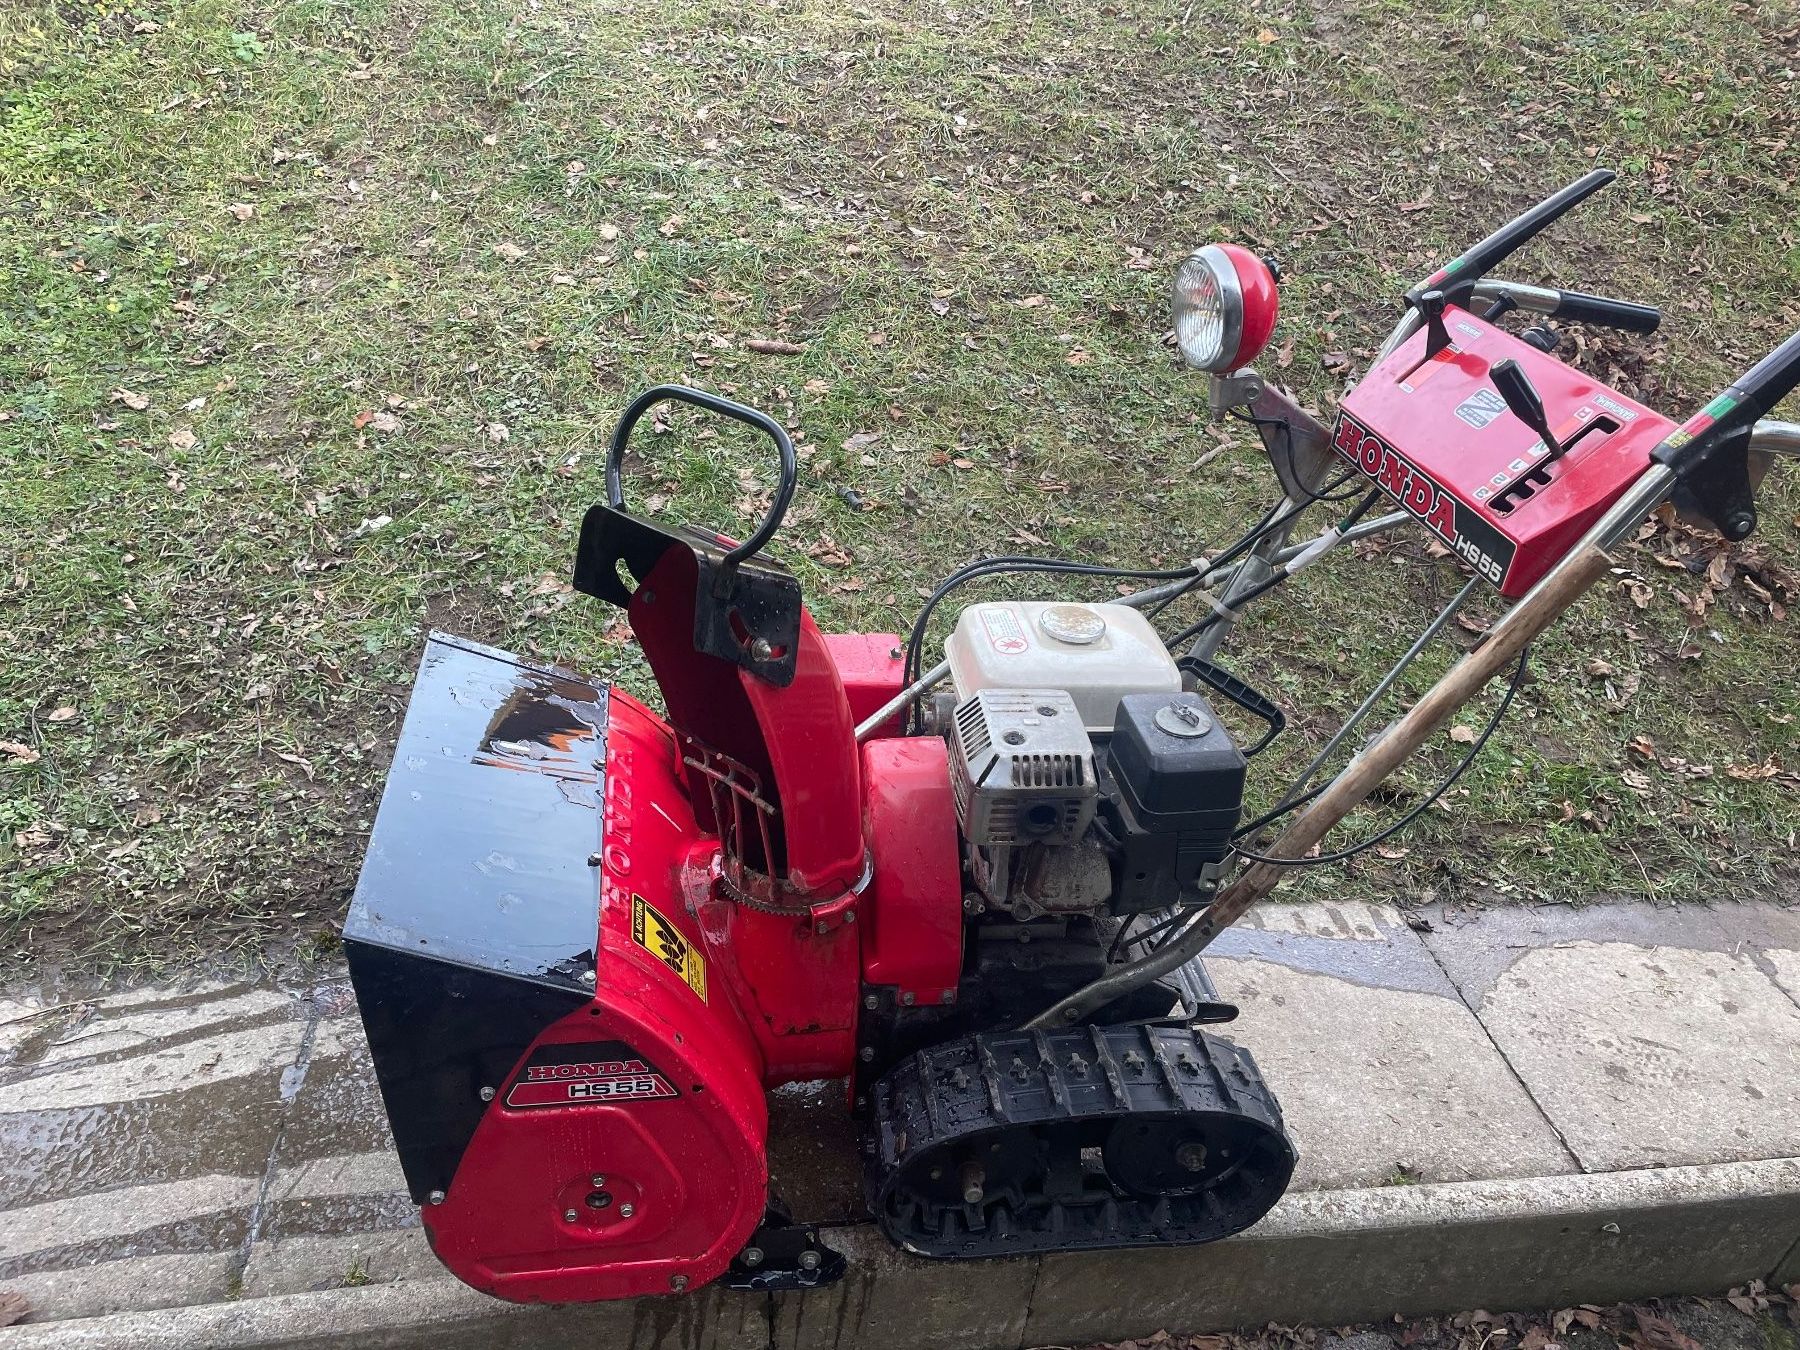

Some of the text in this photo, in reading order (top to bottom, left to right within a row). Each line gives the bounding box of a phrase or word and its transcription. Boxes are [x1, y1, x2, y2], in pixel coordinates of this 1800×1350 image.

[1335, 414, 1503, 583] HONDA HS55
[601, 748, 633, 919] HONDA
[635, 900, 644, 932] ACHTUNG
[528, 1060, 648, 1080] HONDA
